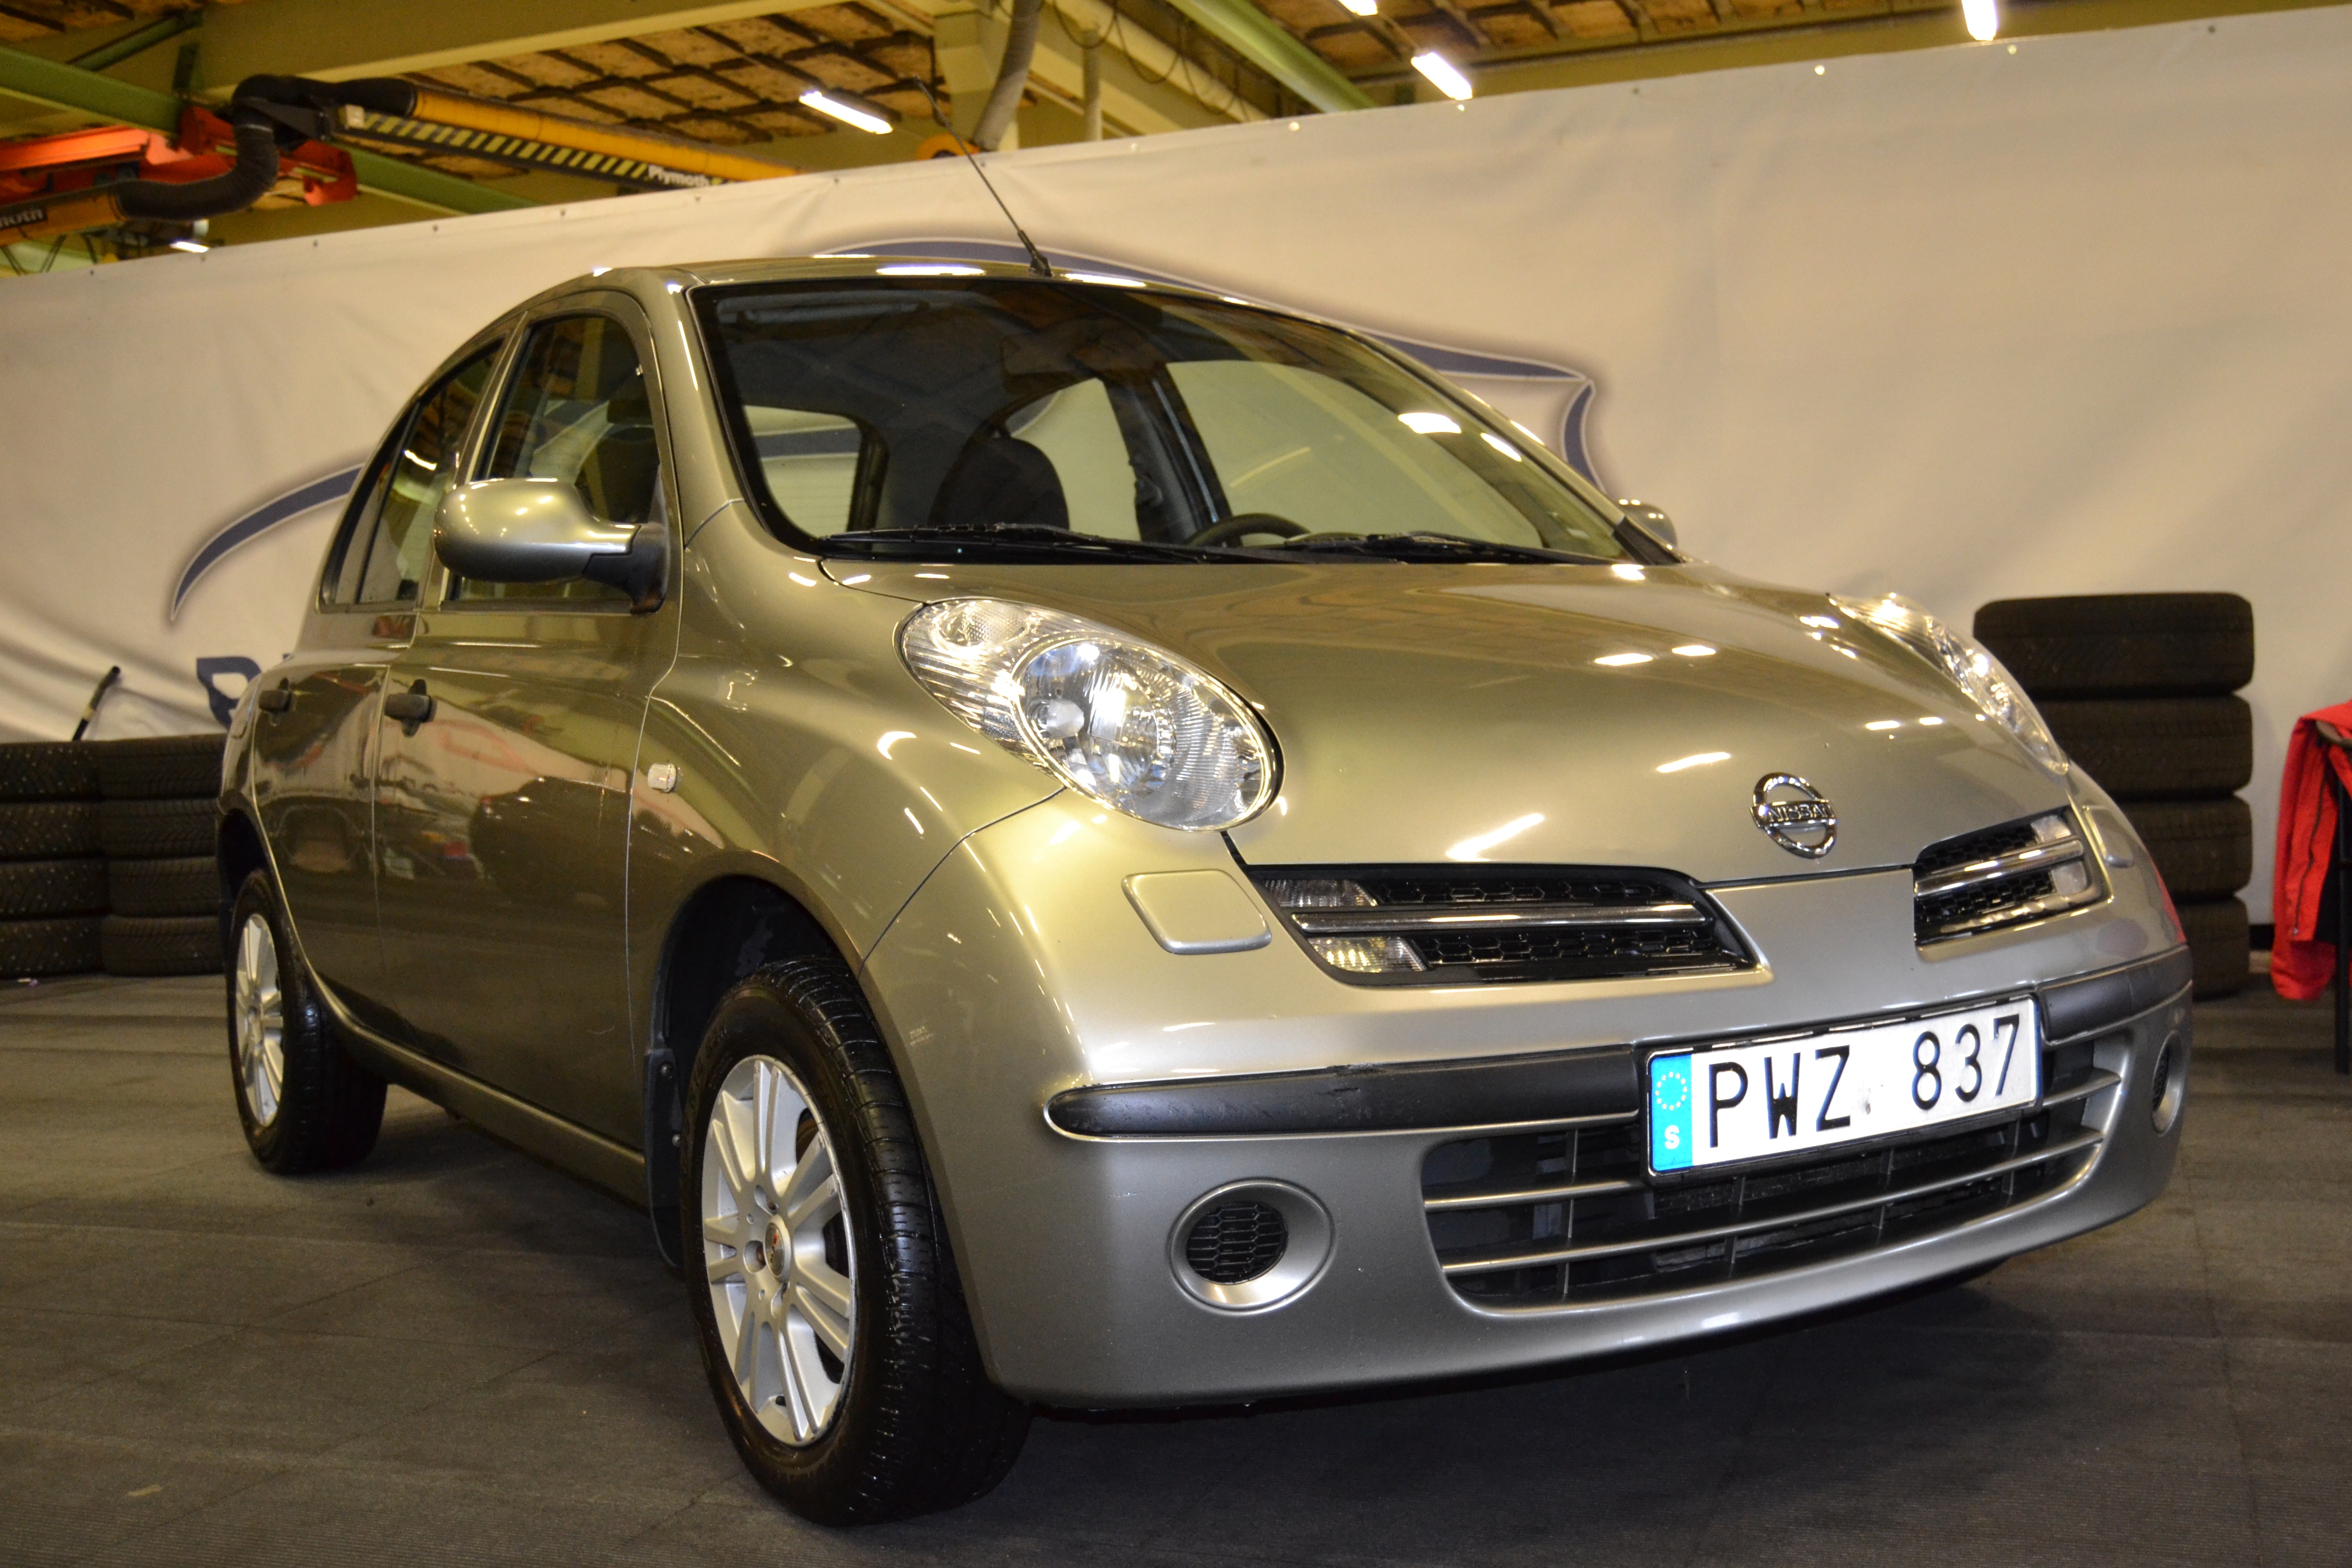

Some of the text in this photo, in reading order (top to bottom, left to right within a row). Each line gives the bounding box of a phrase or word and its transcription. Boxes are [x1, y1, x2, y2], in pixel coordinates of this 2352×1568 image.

[1766, 803, 1836, 822] NISSAN
[1664, 1013, 2020, 1150] S PWZ 837
